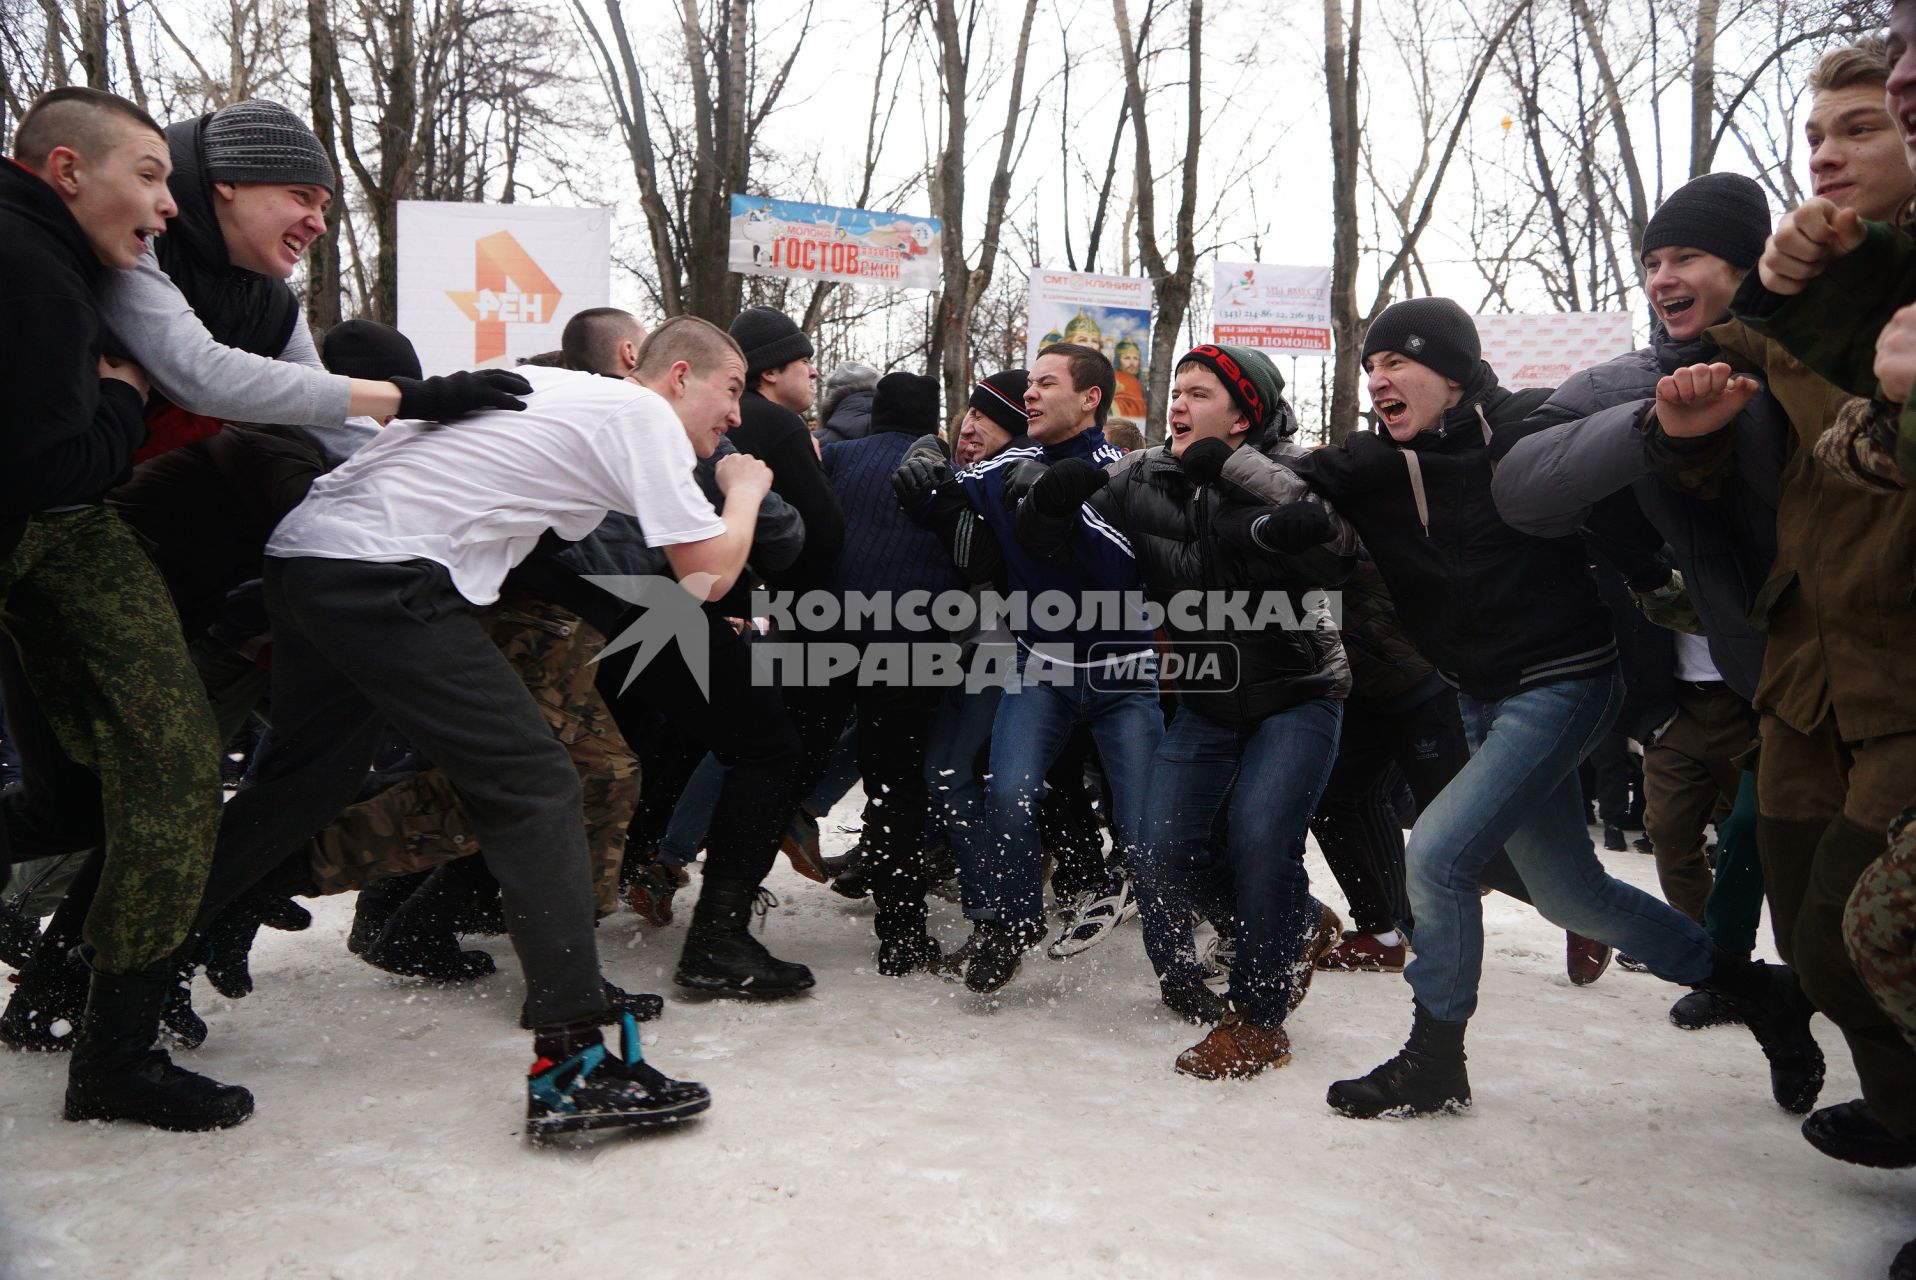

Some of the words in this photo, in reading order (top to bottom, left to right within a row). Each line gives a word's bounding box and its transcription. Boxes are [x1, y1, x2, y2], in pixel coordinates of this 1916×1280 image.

[773, 237, 859, 274] ГОСТОВ
[1043, 275, 1068, 285] СМТ
[1085, 280, 1142, 291] КЛИНИКА
[473, 288, 542, 321] РЕН
[1220, 336, 1259, 346] ваша
[1262, 337, 1328, 349] помощь!
